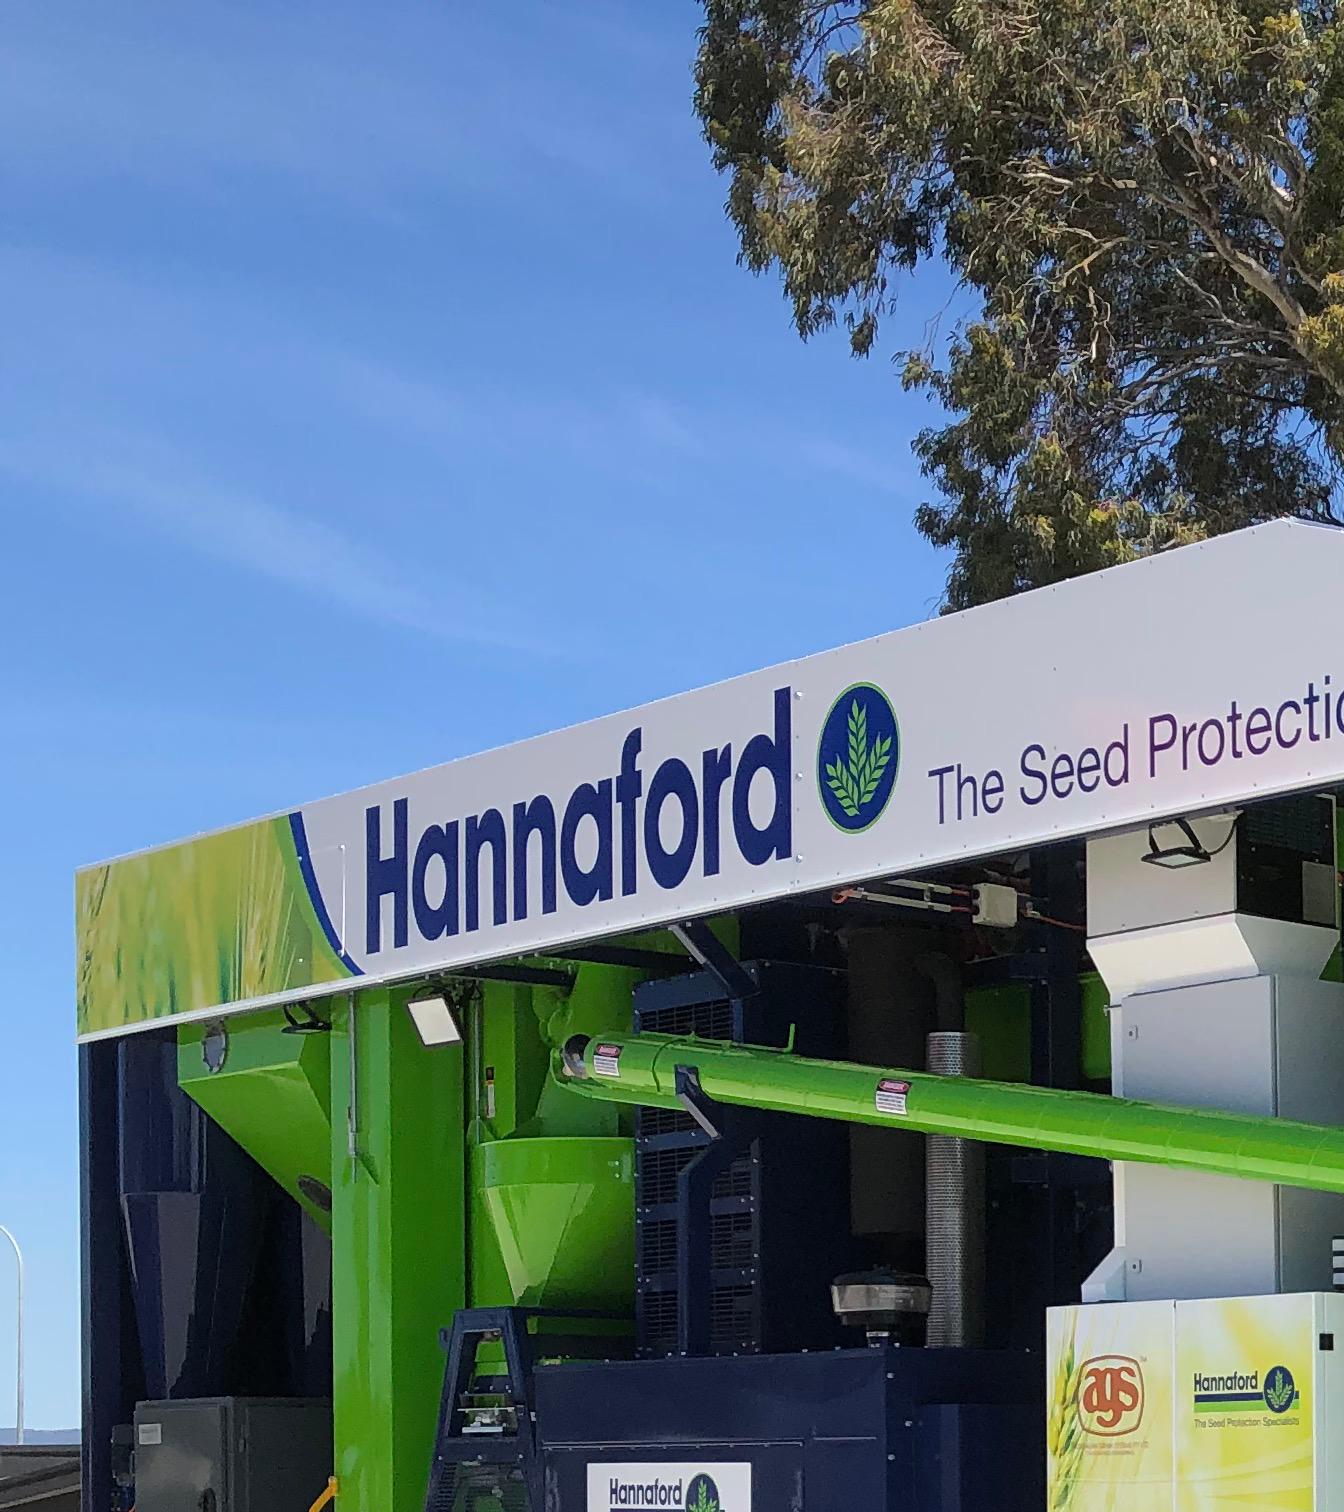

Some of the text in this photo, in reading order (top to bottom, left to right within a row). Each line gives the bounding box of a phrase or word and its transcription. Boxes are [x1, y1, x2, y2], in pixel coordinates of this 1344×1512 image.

[928, 761, 1004, 825] The
[1019, 723, 1130, 801] Seed
[366, 687, 793, 955] Hannaford
[1194, 1371, 1258, 1392] Hannaford
[1195, 1416, 1299, 1428] The Seed Protection Specialists
[610, 1478, 682, 1505] Hannaford
